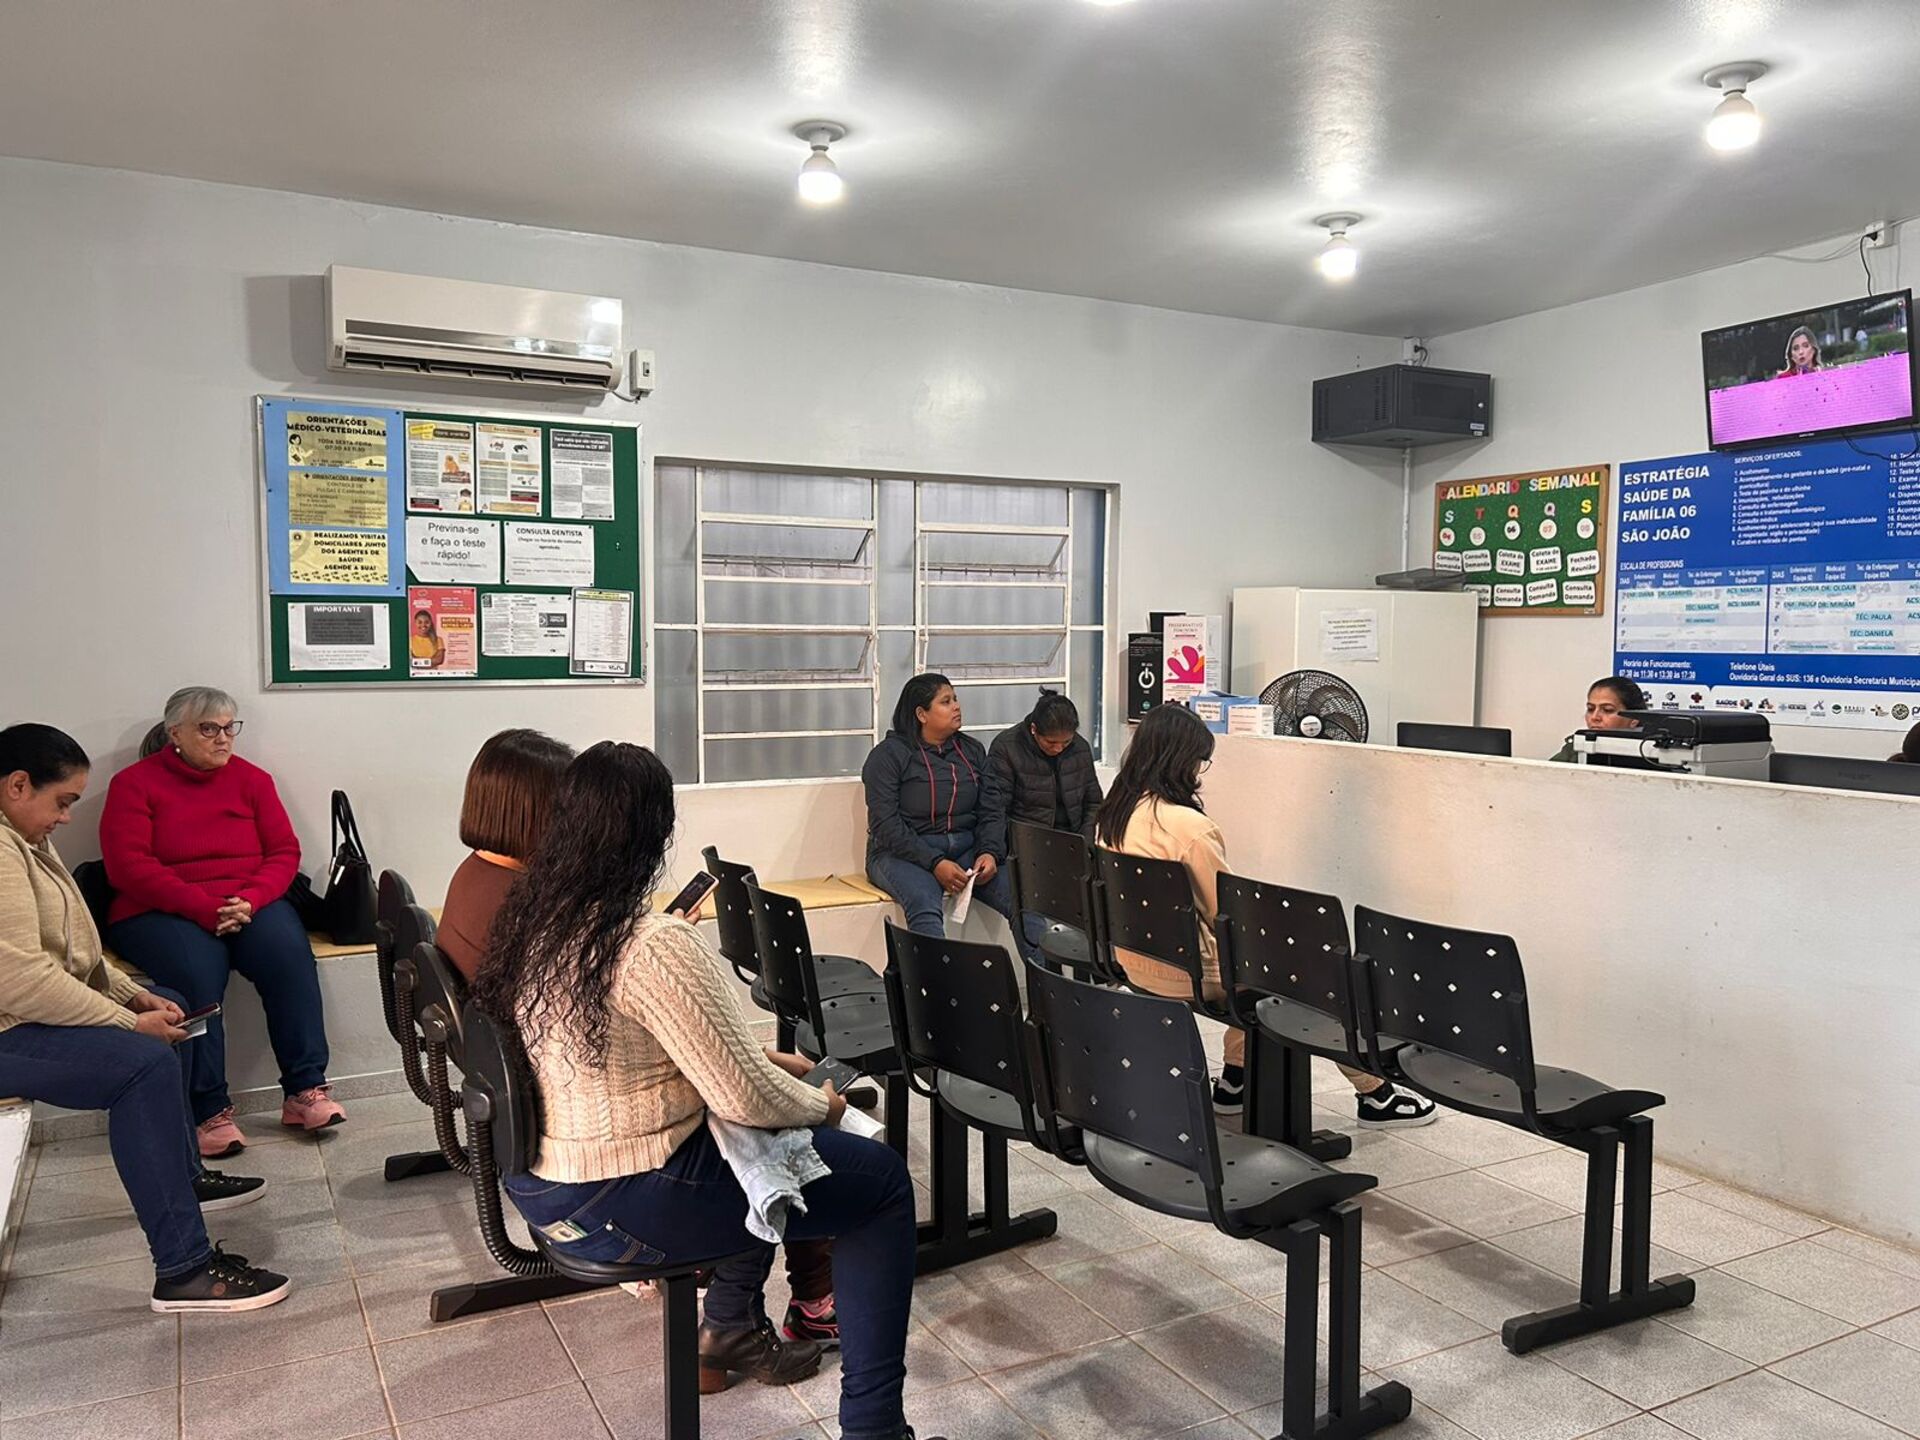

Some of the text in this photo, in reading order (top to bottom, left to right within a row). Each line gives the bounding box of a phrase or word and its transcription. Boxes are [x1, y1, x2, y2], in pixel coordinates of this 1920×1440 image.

[306, 416, 367, 426] ORIENTAÇÕES
[287, 423, 387, 436] MÉDICO-VETERINÁRIAS
[1624, 465, 1710, 486] ESTRATÉGIA
[1529, 472, 1600, 491] SEMANAL
[1624, 486, 1691, 504] SAÚDE DA
[1445, 500, 1592, 523] S T Q Q S
[1623, 504, 1697, 522] FAMÍLIA 06
[428, 522, 480, 534] Previna-se
[516, 528, 582, 537] CONSULTA DENTISTA
[1507, 526, 1516, 534] 06
[1542, 525, 1552, 533] 07
[1622, 526, 1691, 543] SÃO JOÃO
[431, 536, 451, 548] faça
[463, 538, 486, 548] teste
[438, 550, 470, 560] rápido!
[1570, 555, 1596, 564] Fechado
[1571, 564, 1596, 572] Reunião
[1620, 560, 1684, 570] ESCALA DE PROFISSIONAIS
[1772, 570, 1785, 579] DIAS
[1528, 584, 1554, 592] Consulta
[1528, 592, 1556, 601] Demanda
[1623, 659, 1642, 668] Horário
[1650, 660, 1692, 668] Funcionamento:
[1730, 661, 1775, 672] Telefone Úteis
[1640, 670, 1654, 679] 11:30
[1681, 670, 1696, 680] 17:30
[1730, 672, 1758, 682] Ouvidoria
[1758, 673, 1776, 682] Geral
[1786, 674, 1802, 682] SUS:
[1803, 674, 1814, 683] 136
[1820, 674, 1851, 684] Ouvidoria
[1854, 676, 1888, 686] Secretaria
